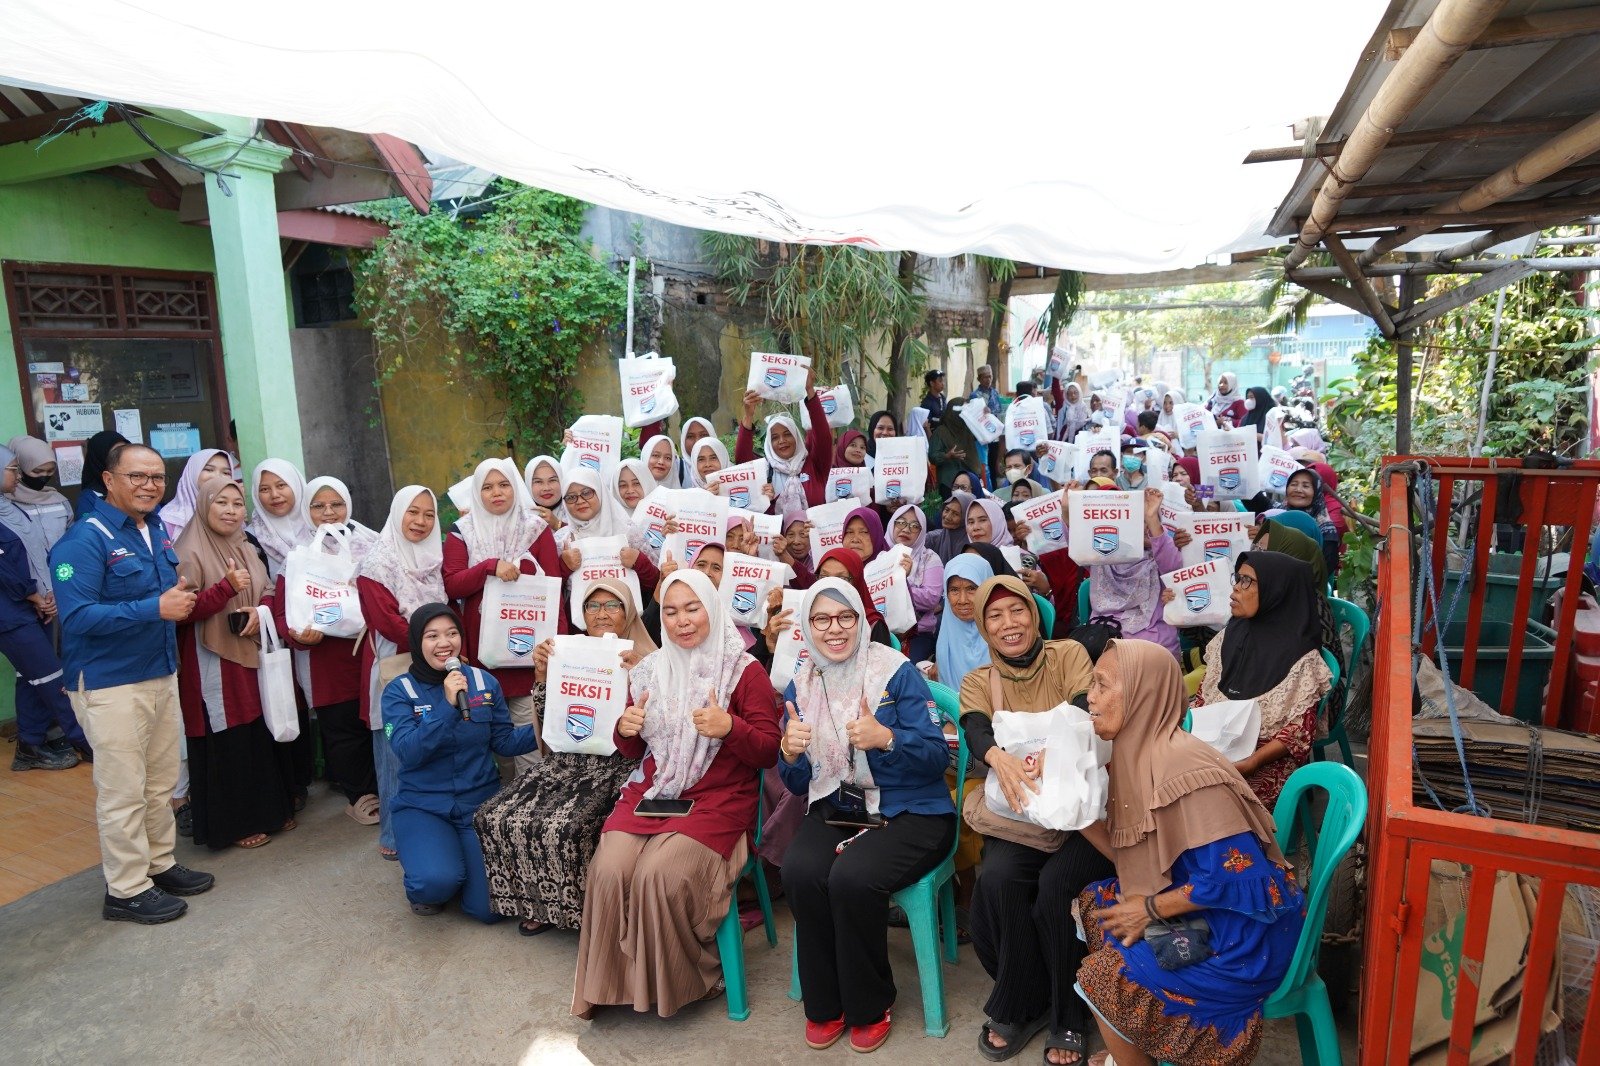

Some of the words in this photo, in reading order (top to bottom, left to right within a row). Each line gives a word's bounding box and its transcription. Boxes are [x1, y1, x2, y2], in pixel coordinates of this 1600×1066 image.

[762, 354, 791, 366] SEKSI
[1014, 420, 1034, 428] SEKSI
[574, 440, 603, 452] SEKSI
[606, 444, 610, 453] 1
[1210, 454, 1240, 464] SEKSI
[1270, 458, 1294, 470] SEKSI
[882, 467, 904, 476] SEKSI
[906, 466, 909, 474] 1
[719, 472, 749, 484] SEKSI
[751, 472, 756, 480] 1
[646, 506, 668, 521] SEK
[1026, 501, 1057, 520] SEKSI
[1083, 509, 1121, 520] SEKSI
[1124, 509, 1130, 520] 1
[1160, 508, 1176, 520] SEK
[678, 522, 710, 536] SEKSI
[712, 526, 717, 536] 1
[1194, 524, 1232, 534] SEKSI
[1236, 522, 1240, 532] 1
[582, 568, 619, 580] SEKSI
[622, 568, 626, 578] 1
[732, 566, 763, 579] SEKSI
[766, 569, 770, 580] 1
[1173, 564, 1208, 583] SEKSI
[1210, 562, 1216, 572] 1
[306, 585, 340, 599] SEKSI
[500, 608, 538, 621] SEKSI
[541, 610, 546, 622] 1
[560, 682, 602, 700] SEKSI
[605, 687, 612, 700] 1
